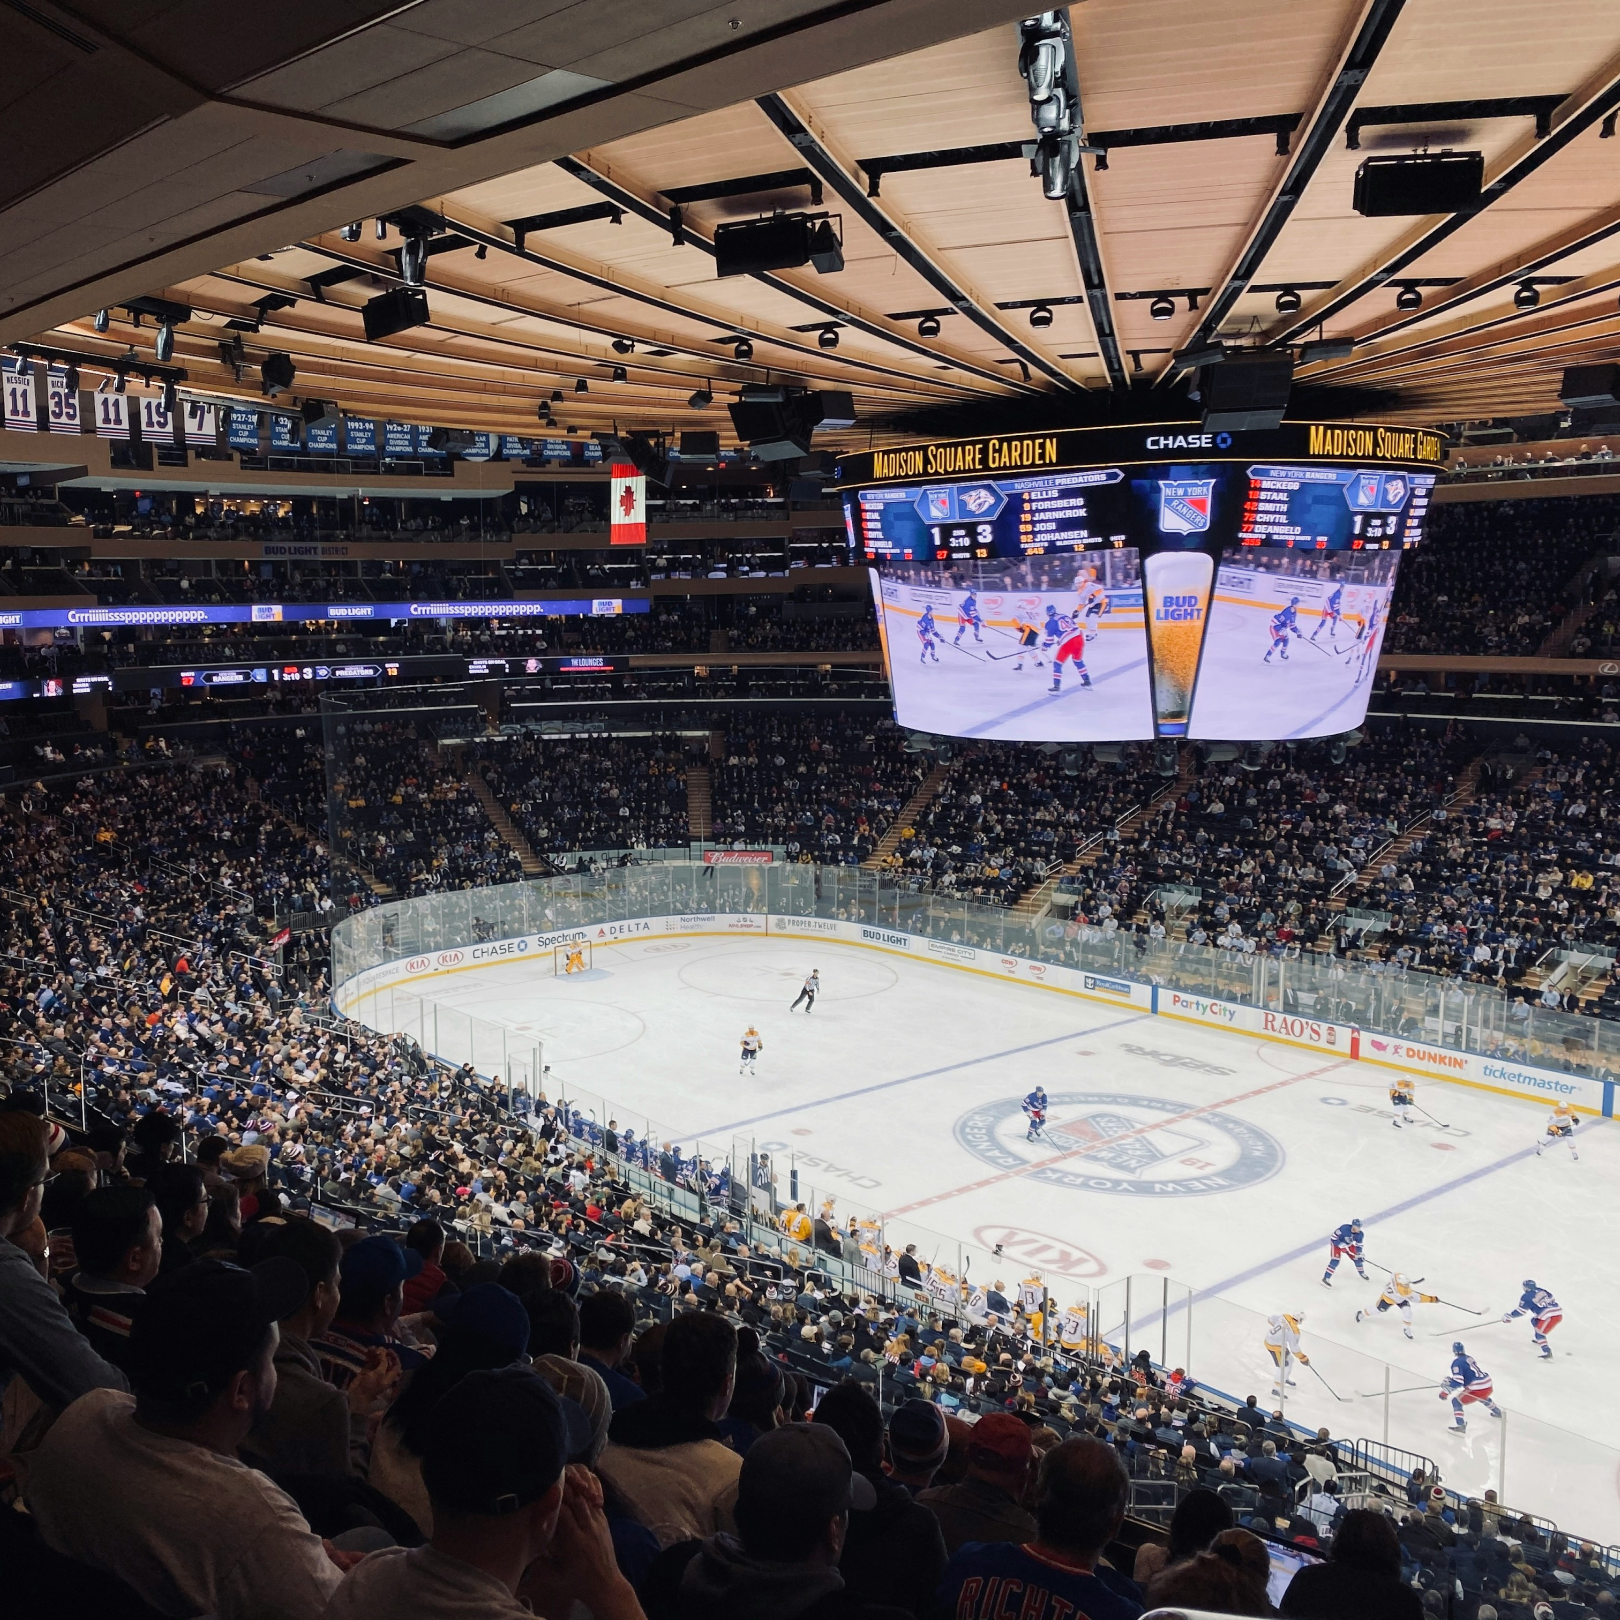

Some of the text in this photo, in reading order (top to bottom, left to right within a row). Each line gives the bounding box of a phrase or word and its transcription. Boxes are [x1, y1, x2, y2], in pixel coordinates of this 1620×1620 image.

[9, 387, 31, 418] 11
[50, 391, 77, 421] 35
[101, 397, 122, 425] 11
[144, 401, 168, 429] 19
[232, 423, 254, 431] STANLEY
[348, 422, 374, 431] 1993-94
[238, 430, 249, 438] CUP
[229, 437, 258, 445] CHAMPIONS
[1146, 434, 1214, 450] CHASE
[1310, 426, 1442, 462] MADISON SQUARE GARDEN
[874, 438, 1057, 478] MADISON SQUARE GARDEN
[1014, 474, 1107, 489] NASHVILLE PREDATORS
[1306, 472, 1337, 480] RANGERS
[1165, 486, 1208, 496] NEW YORK
[1262, 480, 1300, 490] MCKEGG
[1022, 490, 1059, 500] 4 ELLIS
[1260, 491, 1290, 500] STAAL
[1032, 498, 1084, 510] FORSBERG
[1244, 502, 1288, 512] 42 SMITH
[1020, 508, 1088, 522] 19 JARNKROK
[1170, 500, 1206, 527] RANGERS
[1244, 512, 1290, 523] 72 CHYTIL
[1033, 522, 1056, 532] JOSI
[1254, 525, 1302, 534] DEANGELO
[1353, 515, 1364, 534] 1
[1386, 516, 1397, 534] 3
[931, 527, 940, 546] 1
[976, 524, 992, 544] 3
[1034, 530, 1088, 542] JOHANSEN
[1366, 527, 1382, 537] 3:10
[950, 537, 970, 547] 3:10
[1074, 544, 1085, 552] 12
[1114, 540, 1124, 548] 11
[1352, 540, 1364, 550] 27
[264, 546, 348, 556] BUD LIGHT DISTRICT
[936, 550, 948, 560] 27
[976, 548, 988, 558] 13
[1162, 595, 1198, 608] BUD
[254, 613, 276, 621] LIGHT
[330, 608, 373, 616] BUD LIGHT
[1156, 608, 1203, 621] LIGHT
[578, 658, 604, 666] LOUNGES
[272, 669, 280, 681] 1
[282, 673, 300, 682] 3:10
[302, 667, 312, 680] 3
[336, 668, 374, 676] PREDATORS
[387, 668, 398, 676] 13
[182, 676, 194, 686] 27
[212, 674, 244, 683] RANGERS
[708, 852, 768, 864] Budweiser
[610, 922, 650, 935] DELTA
[538, 931, 584, 948] Spectrum
[862, 929, 908, 948] BUD LIGHT
[472, 942, 515, 958] CHASE
[930, 944, 973, 958] EMPIRE CITY
[409, 959, 426, 970] KIA
[442, 953, 460, 964] KIA
[1262, 1012, 1321, 1042] RAO'S
[1406, 1047, 1468, 1070] DUNKIN'
[1483, 1064, 1577, 1095] ticketmaster
[965, 1114, 1024, 1168] RANGERS
[1179, 1157, 1216, 1170] 19
[782, 1150, 882, 1190] CHASE
[1044, 1170, 1136, 1192] YORK
[1154, 1176, 1230, 1193] NEW
[996, 1230, 1092, 1272] KIA
[970, 1295, 981, 1307] 8
[1024, 1290, 1034, 1305] 13
[1064, 1316, 1080, 1336] 23
